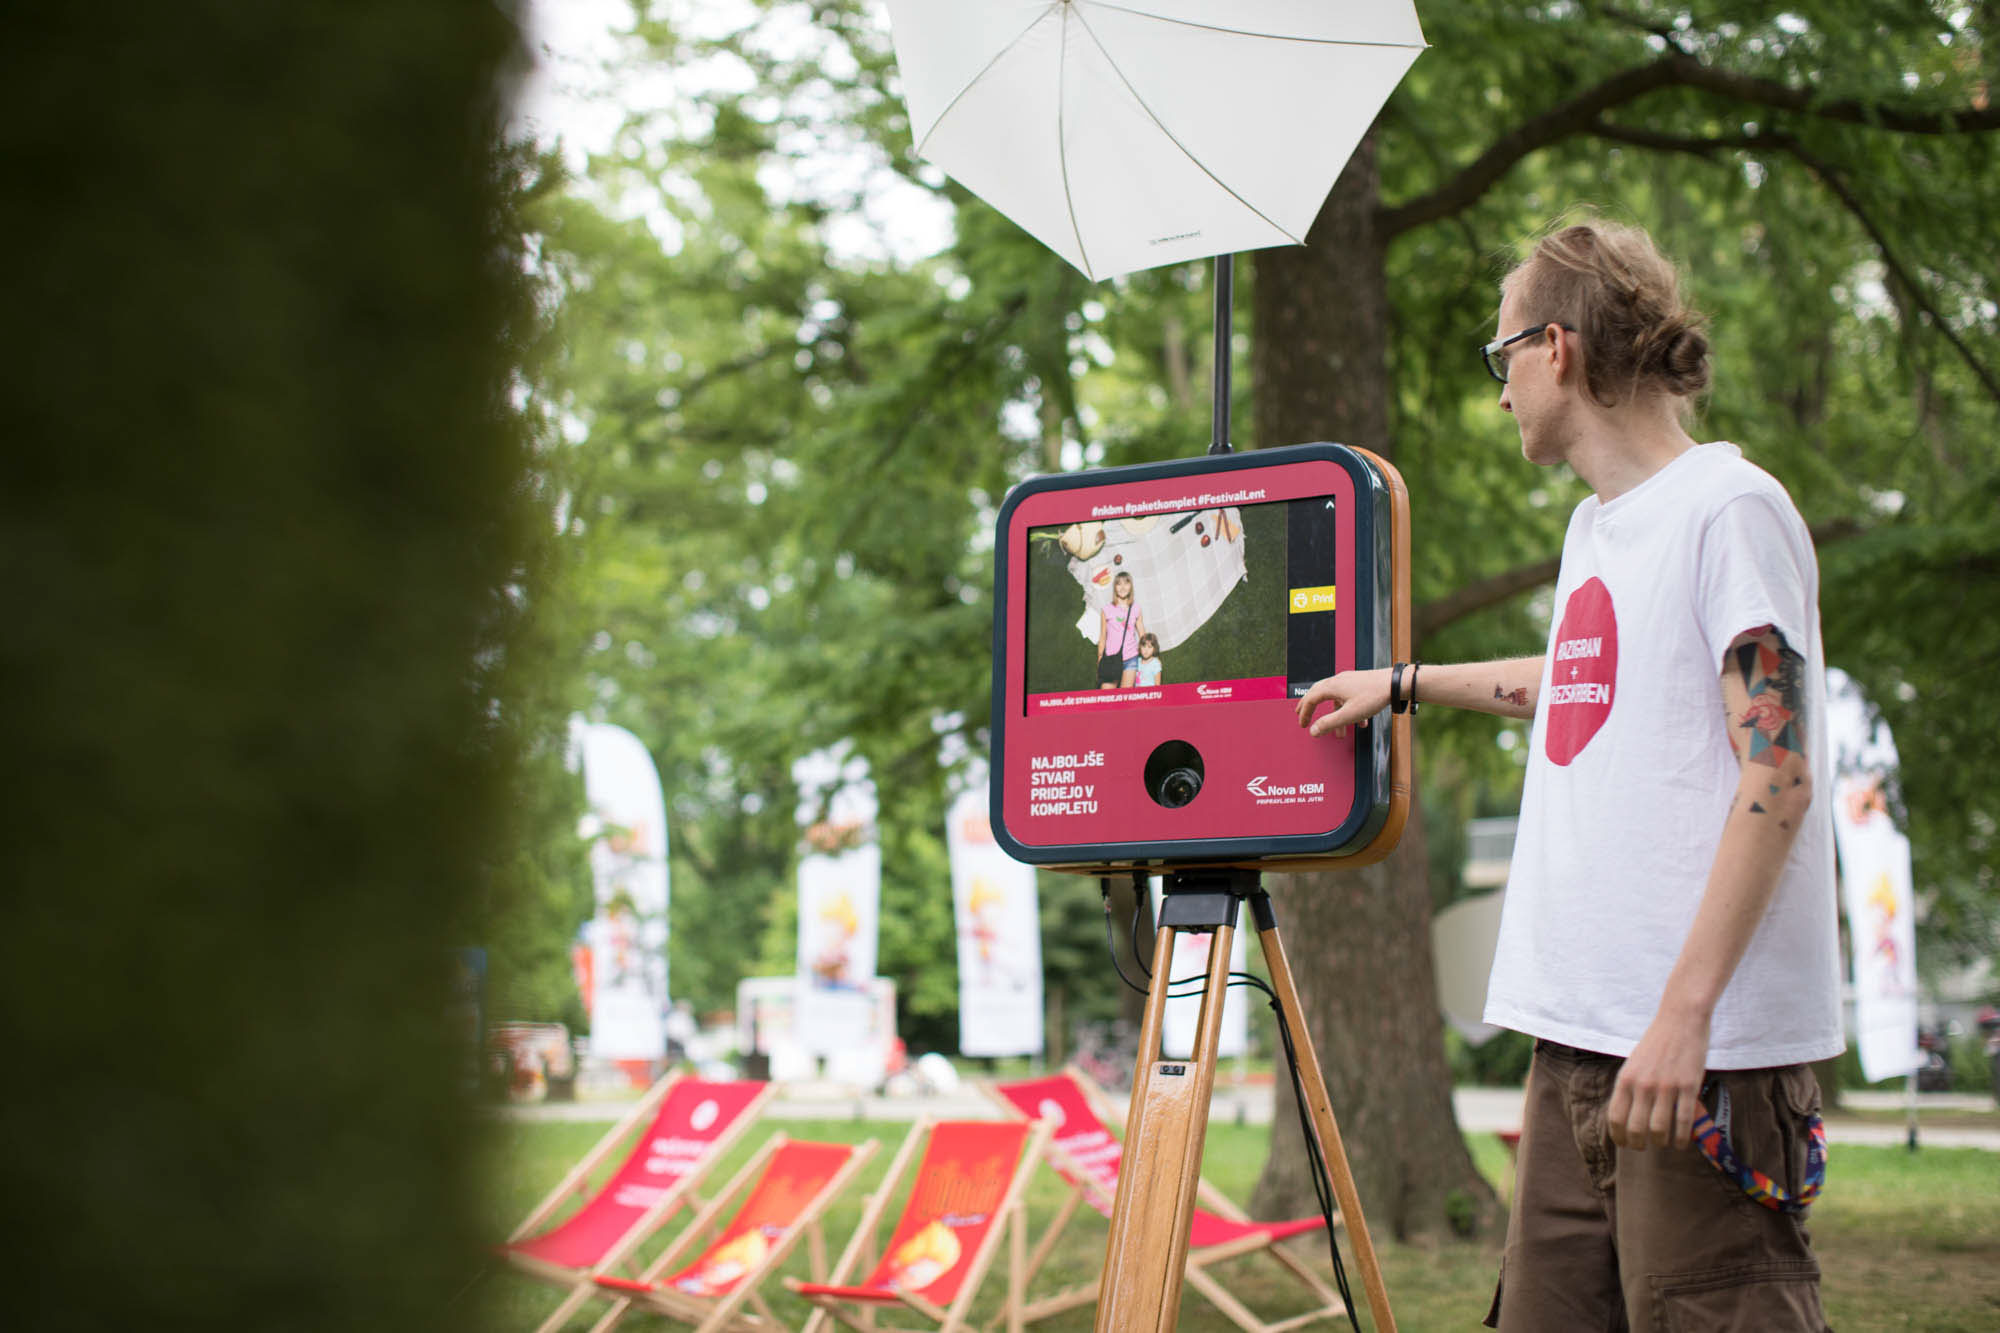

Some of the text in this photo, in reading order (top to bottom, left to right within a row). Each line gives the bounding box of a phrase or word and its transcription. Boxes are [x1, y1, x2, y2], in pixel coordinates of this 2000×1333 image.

[1125, 496, 1197, 514] #paketkomplet
[1031, 750, 1105, 770] NAJBOLJŠE
[1031, 770, 1075, 786] STVARI
[1030, 784, 1095, 801] PRIDEJO V
[1268, 783, 1325, 796] Nova KBM
[1030, 800, 1098, 817] KOMPLETU
